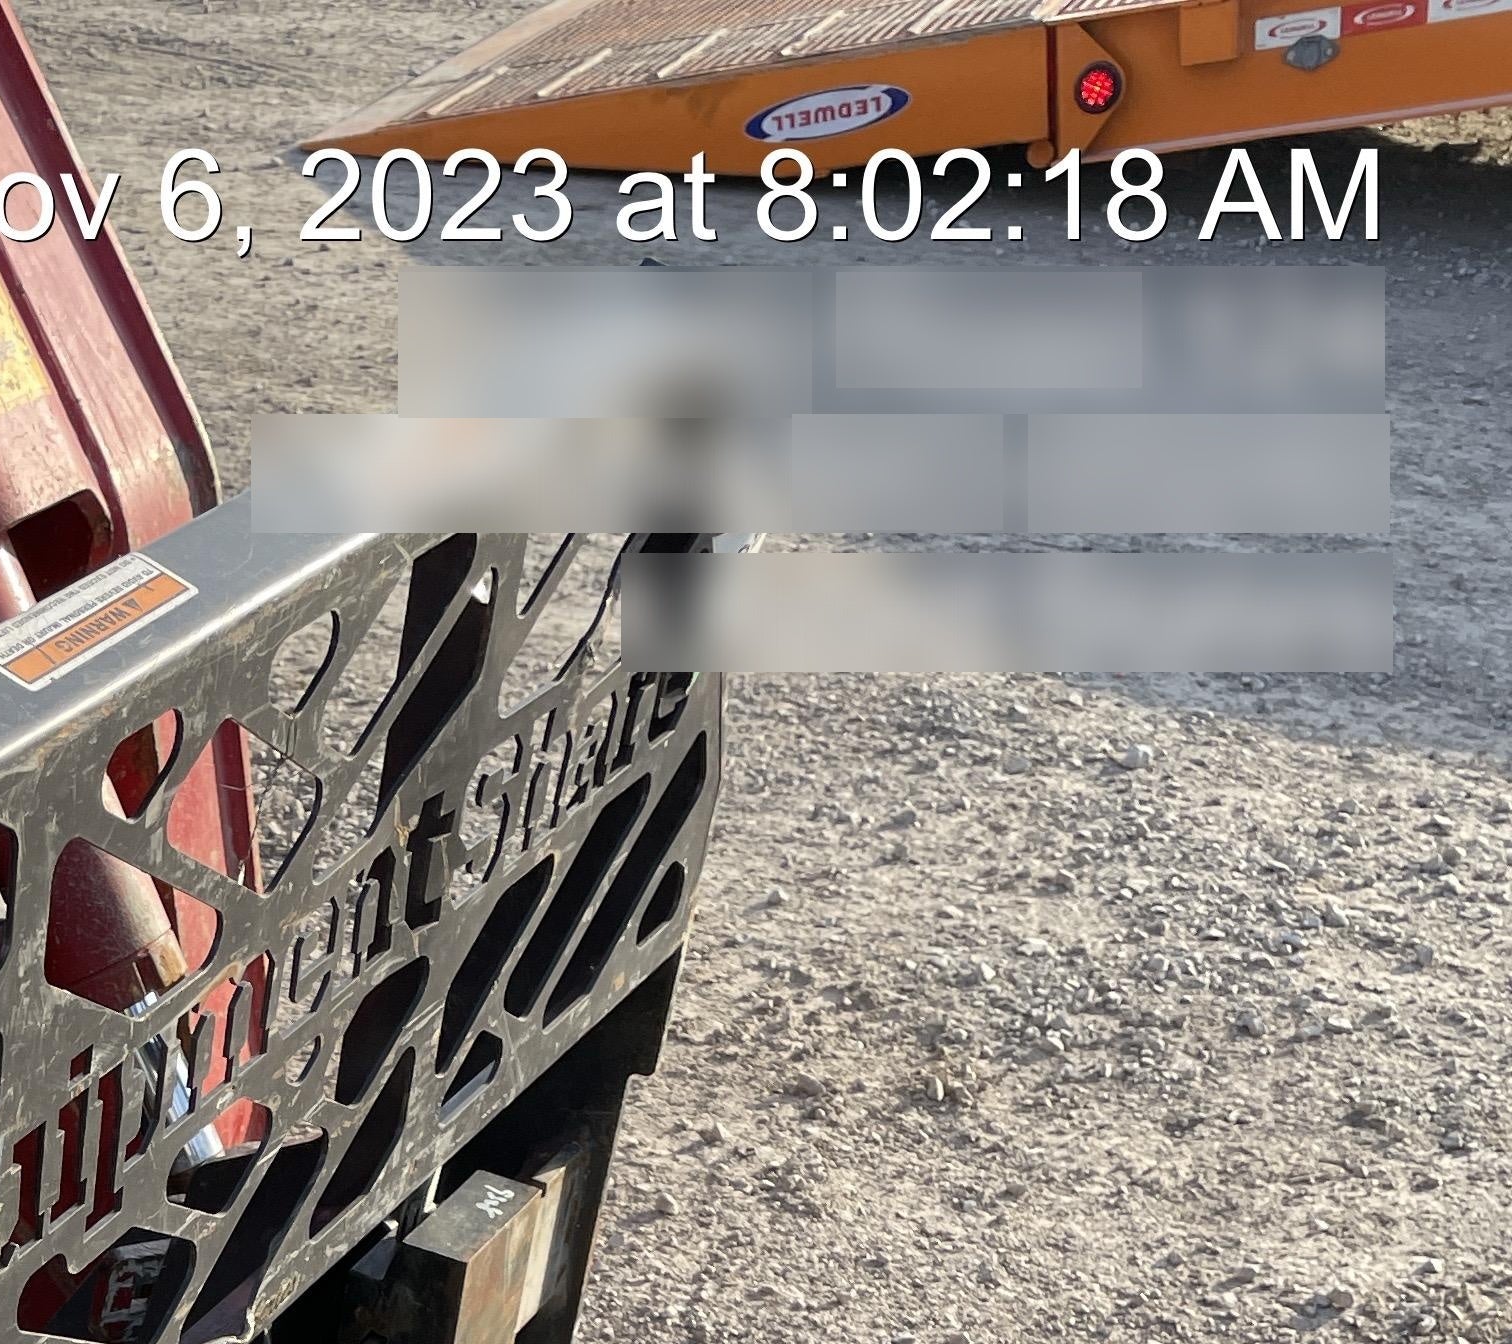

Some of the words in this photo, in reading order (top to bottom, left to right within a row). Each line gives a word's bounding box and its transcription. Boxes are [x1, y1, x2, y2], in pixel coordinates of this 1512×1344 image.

[772, 96, 883, 131] LEDWELL
[58, 600, 99, 623] PERSONAL
[55, 607, 130, 653] WARNING
